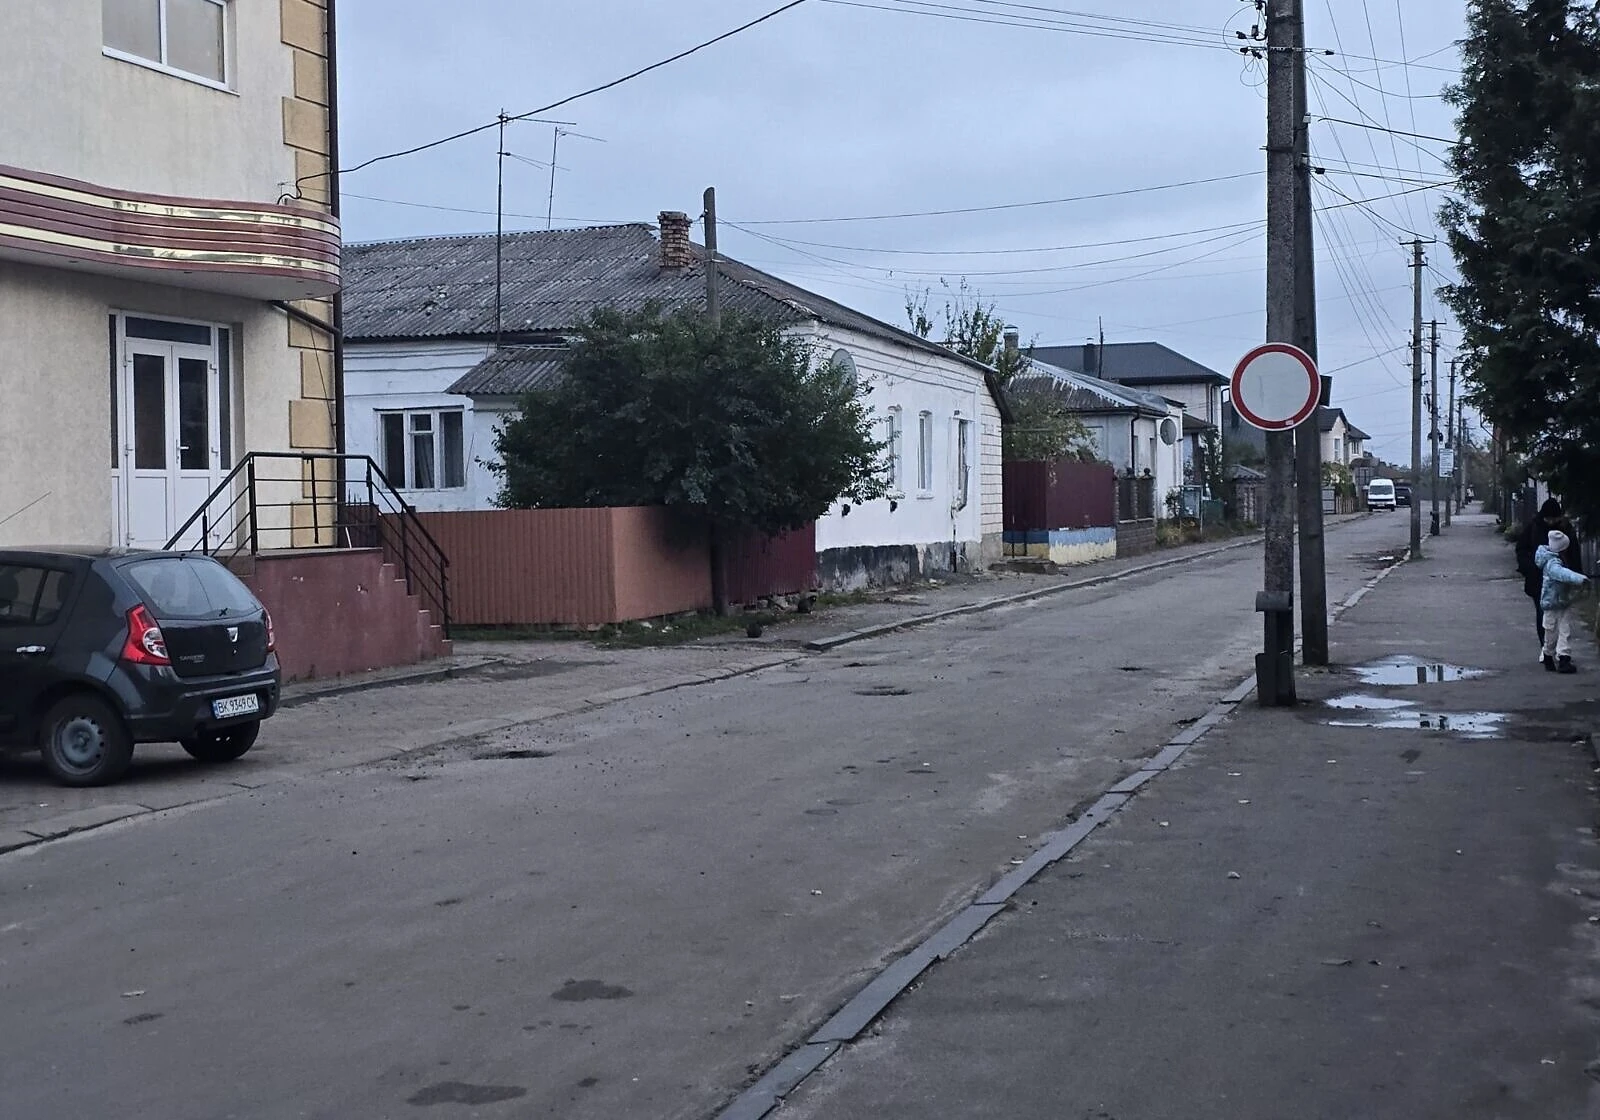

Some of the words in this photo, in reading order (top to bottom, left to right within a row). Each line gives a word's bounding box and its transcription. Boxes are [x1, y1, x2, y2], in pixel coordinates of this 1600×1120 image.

[217, 701, 229, 713] BK
[230, 698, 246, 711] 9349
[246, 696, 256, 708] CK
